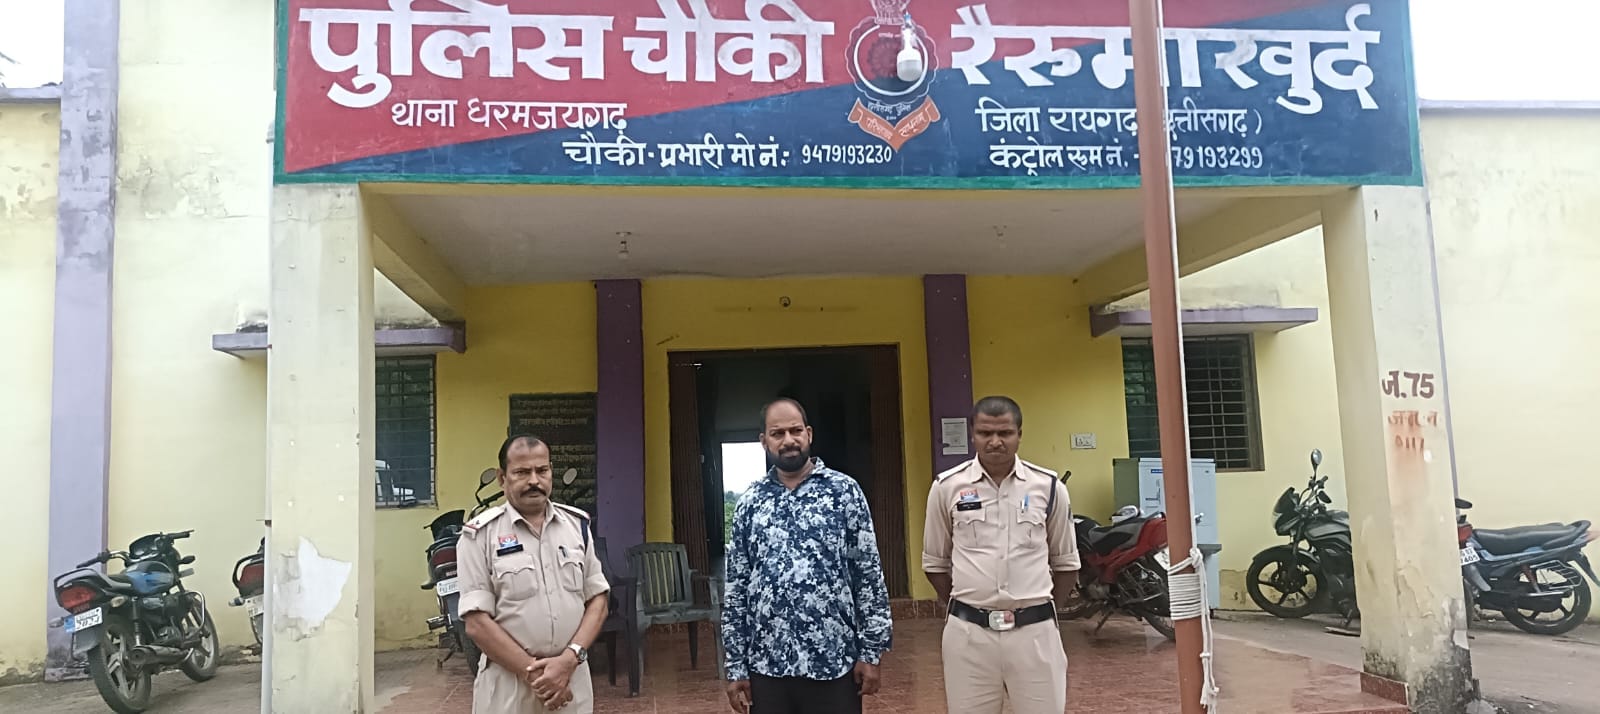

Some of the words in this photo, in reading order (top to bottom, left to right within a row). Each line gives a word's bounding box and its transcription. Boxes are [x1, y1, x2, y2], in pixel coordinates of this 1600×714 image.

[298, 0, 614, 109] पुलिस
[623, 0, 835, 84] चौकी
[391, 99, 458, 128] थाना
[467, 97, 628, 134] धरमजयगढ़
[974, 97, 1041, 134] जिला
[1047, 107, 1139, 137] रायगढ़
[726, 132, 756, 167] मो
[801, 144, 893, 165] 9479193230
[989, 136, 1064, 176] कंट्रोल
